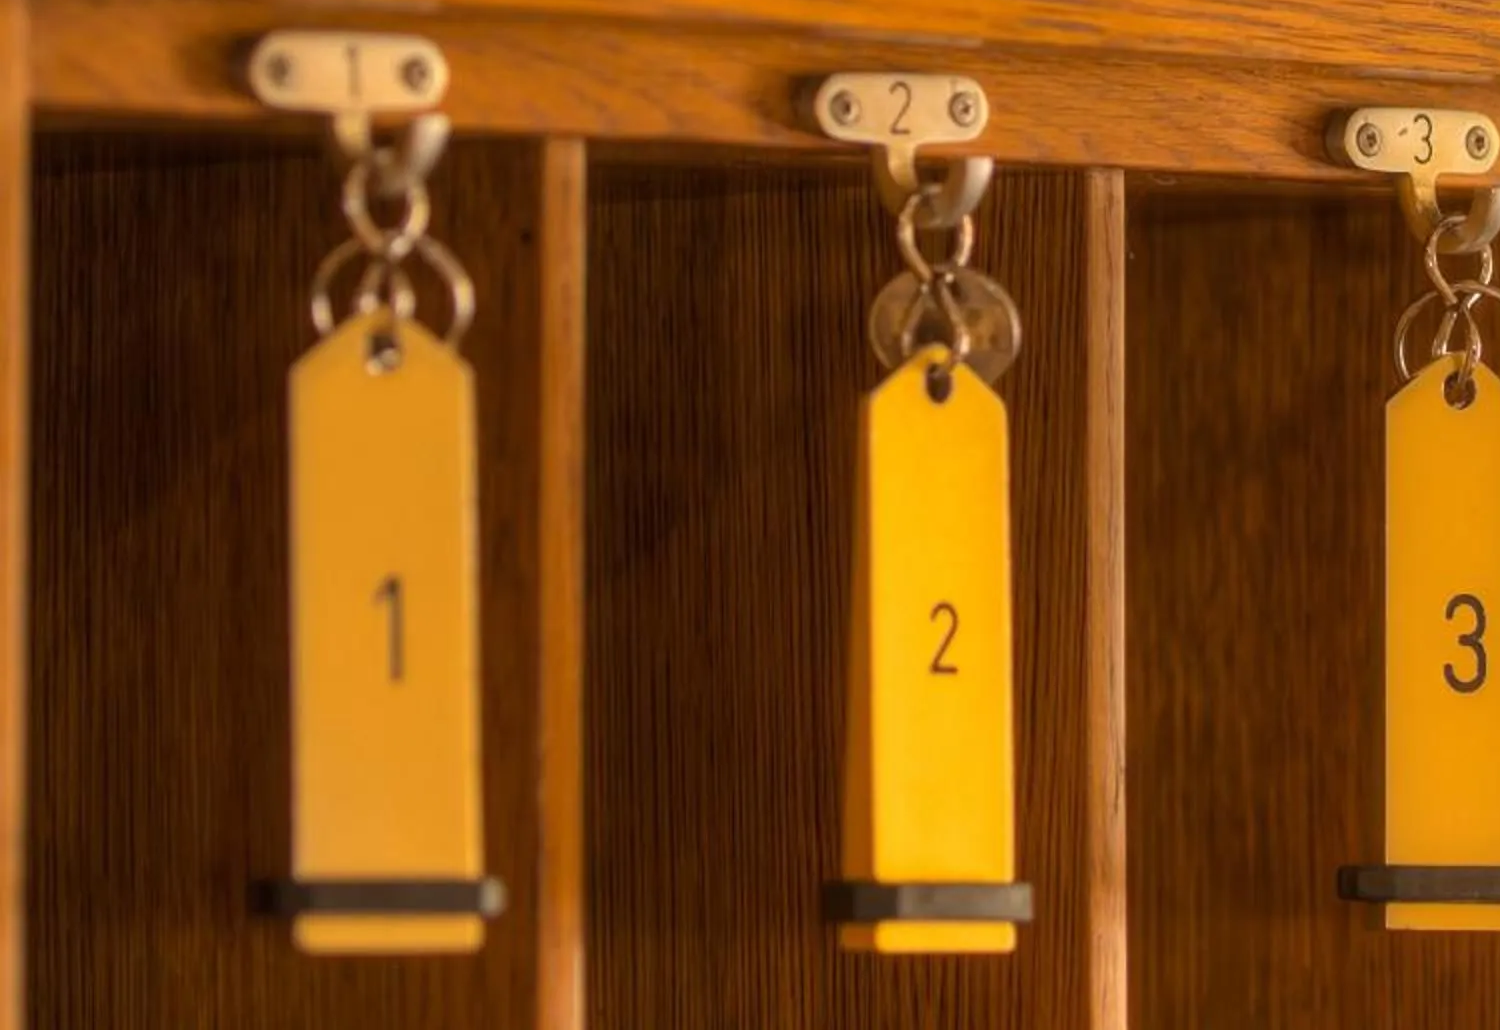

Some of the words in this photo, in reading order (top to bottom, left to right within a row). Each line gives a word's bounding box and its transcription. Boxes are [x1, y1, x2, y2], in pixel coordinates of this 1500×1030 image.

[341, 42, 362, 100] 1
[888, 79, 912, 135] 2
[1412, 112, 1434, 165] 3
[373, 572, 405, 685] 1
[928, 601, 960, 676] 2
[1442, 592, 1489, 695] 3
